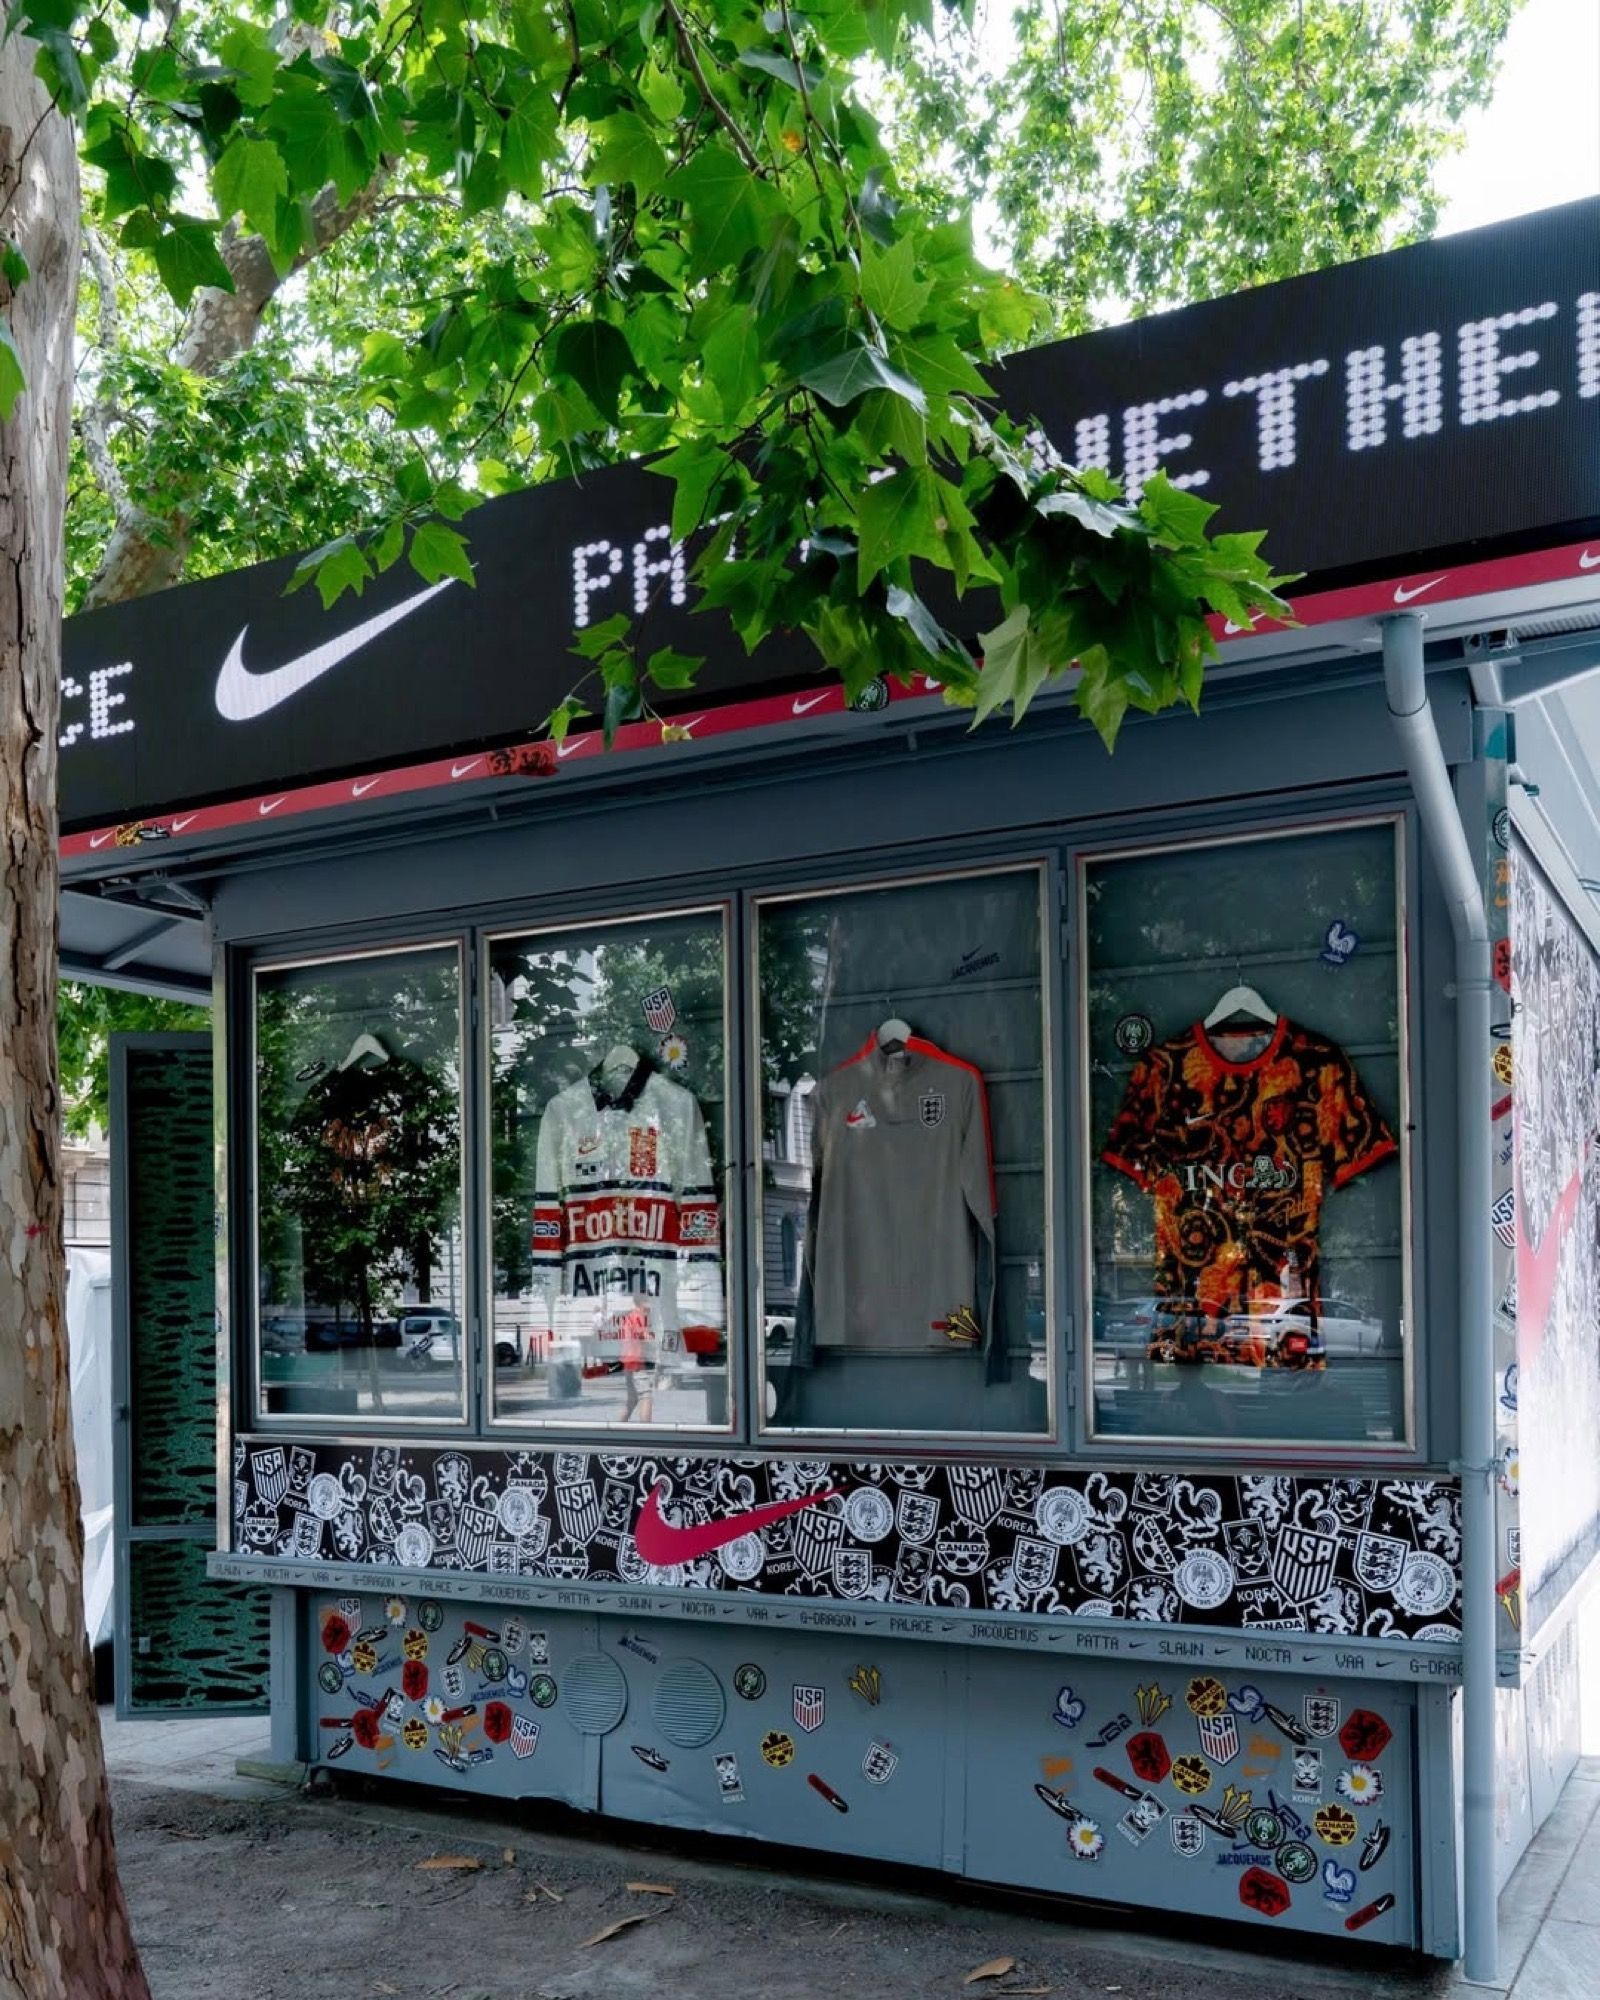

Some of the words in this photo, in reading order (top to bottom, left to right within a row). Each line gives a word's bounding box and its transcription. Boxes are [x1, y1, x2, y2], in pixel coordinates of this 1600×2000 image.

[644, 991, 669, 1011] USA
[1184, 1163, 1245, 1191] ING
[255, 1452, 281, 1475] USA
[560, 1485, 592, 1510] USA
[464, 1509, 496, 1534] USA
[802, 1513, 841, 1541] USA
[596, 1534, 621, 1548] KORE
[938, 1543, 987, 1553] CANADA
[1284, 1531, 1335, 1564] USA
[340, 1600, 360, 1615] USA
[419, 1579, 453, 1594] PALACE
[557, 1592, 590, 1605] PATTA
[681, 1601, 716, 1617] NOCTA
[746, 1607, 768, 1621] VAA
[799, 1611, 856, 1628] G-DRAGON
[890, 1616, 933, 1634] PALACE
[969, 1624, 1039, 1643] JACQUEMUS
[1076, 1632, 1119, 1651] PATTA
[1159, 1640, 1203, 1657] SLAWN
[1245, 1646, 1290, 1665] NOCTA
[1335, 1653, 1363, 1670] VAA
[796, 1688, 822, 1706] USA
[515, 1720, 538, 1737] USA
[1201, 1716, 1233, 1736] USA
